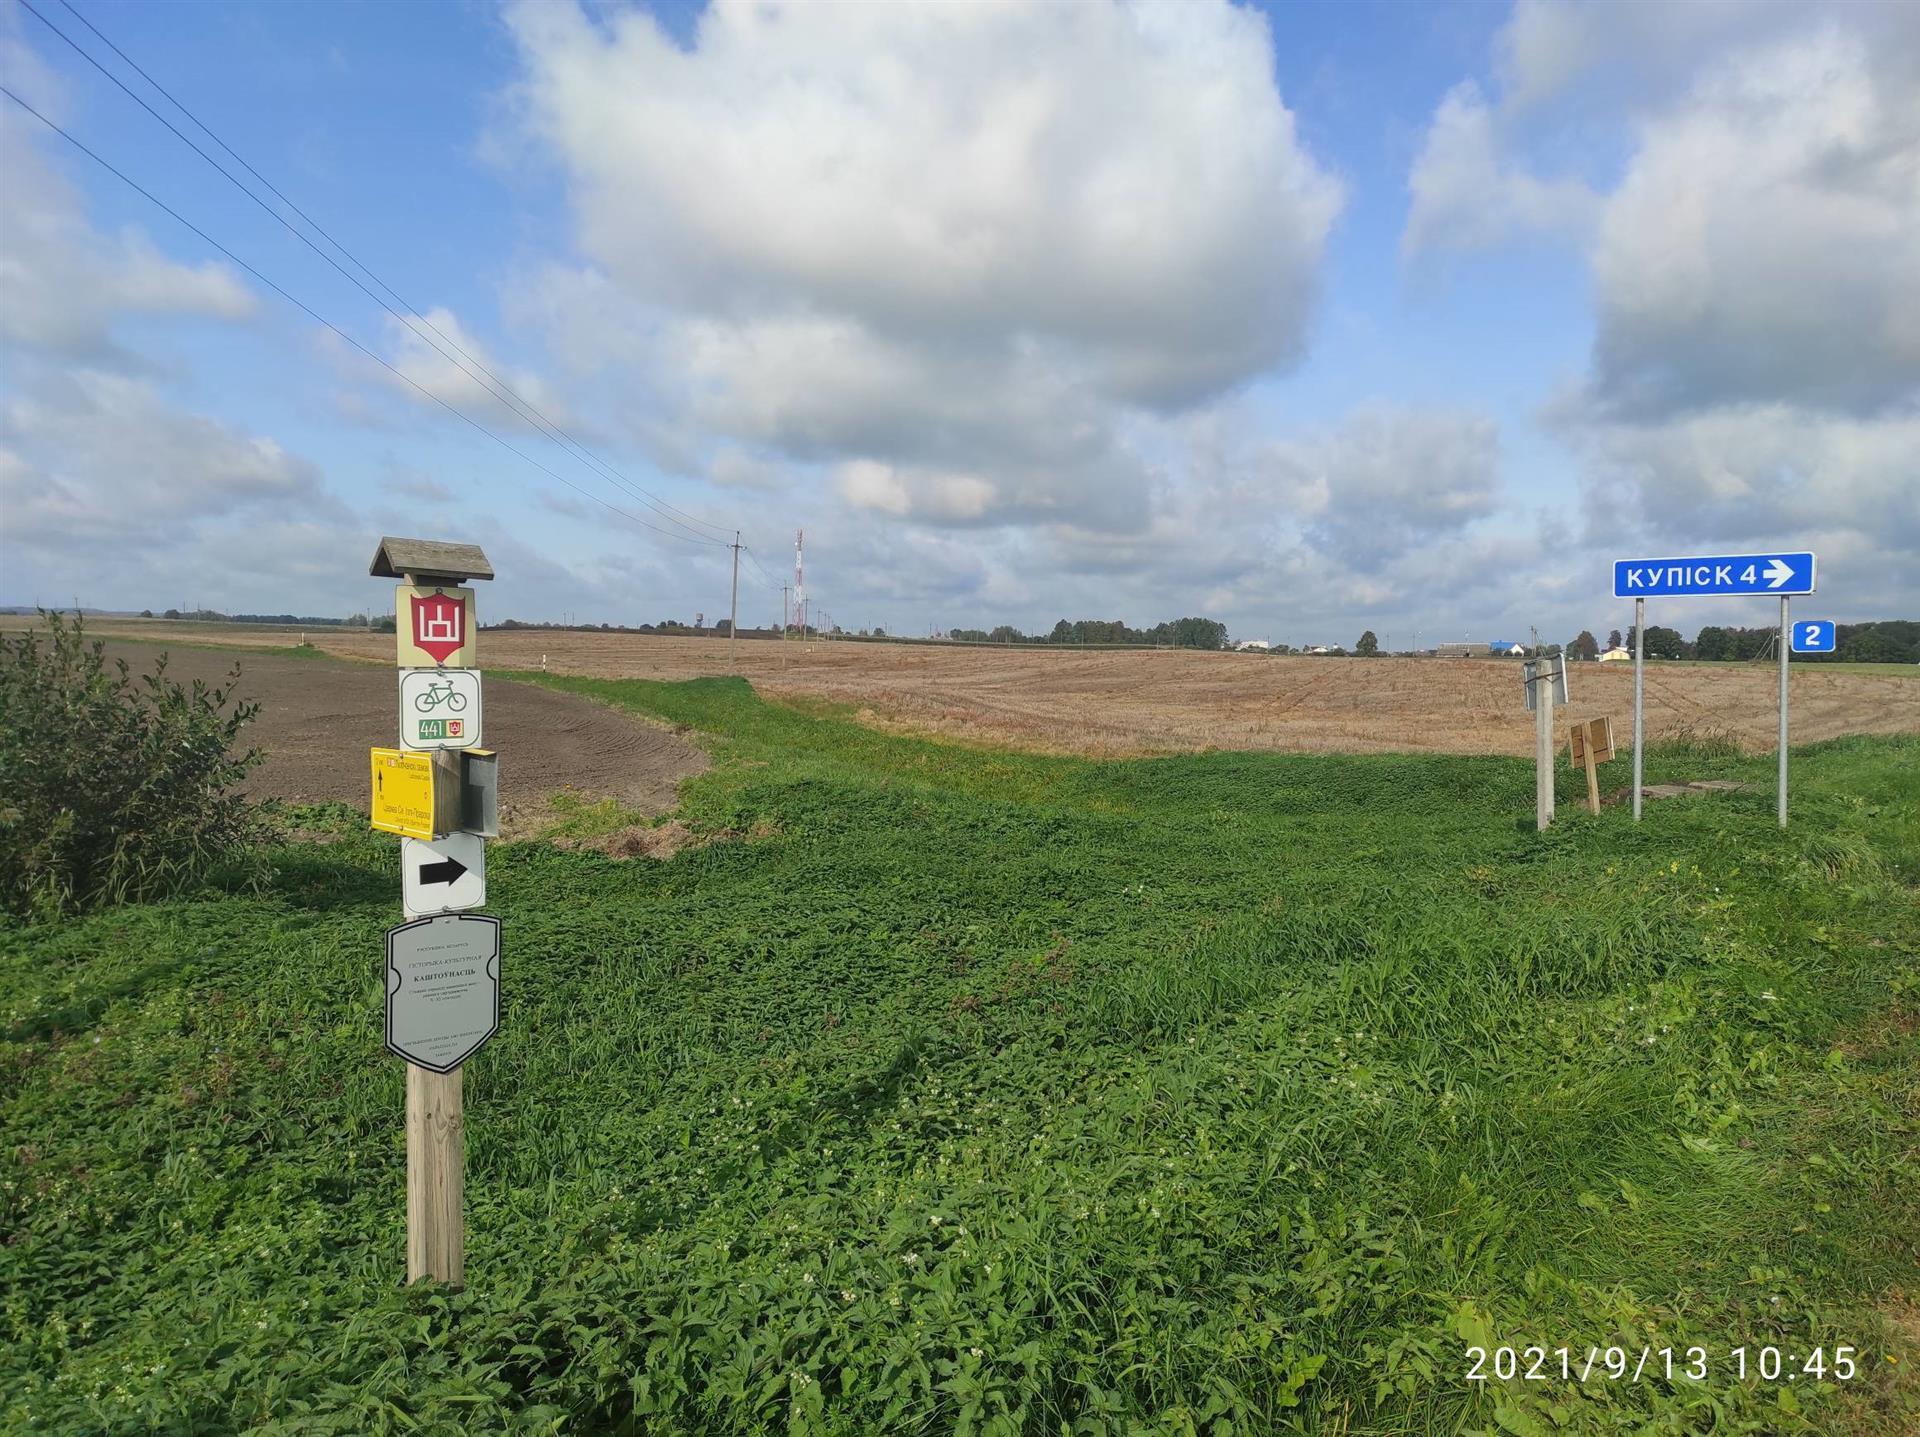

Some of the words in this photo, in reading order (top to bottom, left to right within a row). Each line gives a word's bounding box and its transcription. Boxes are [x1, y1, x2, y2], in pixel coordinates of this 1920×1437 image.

[1627, 564, 1733, 588] КУПІСК
[1740, 564, 1757, 584] 4
[1805, 625, 1821, 646] 2
[420, 720, 443, 737] 441
[413, 968, 476, 983] КАШТОЎНАСЦЬ
